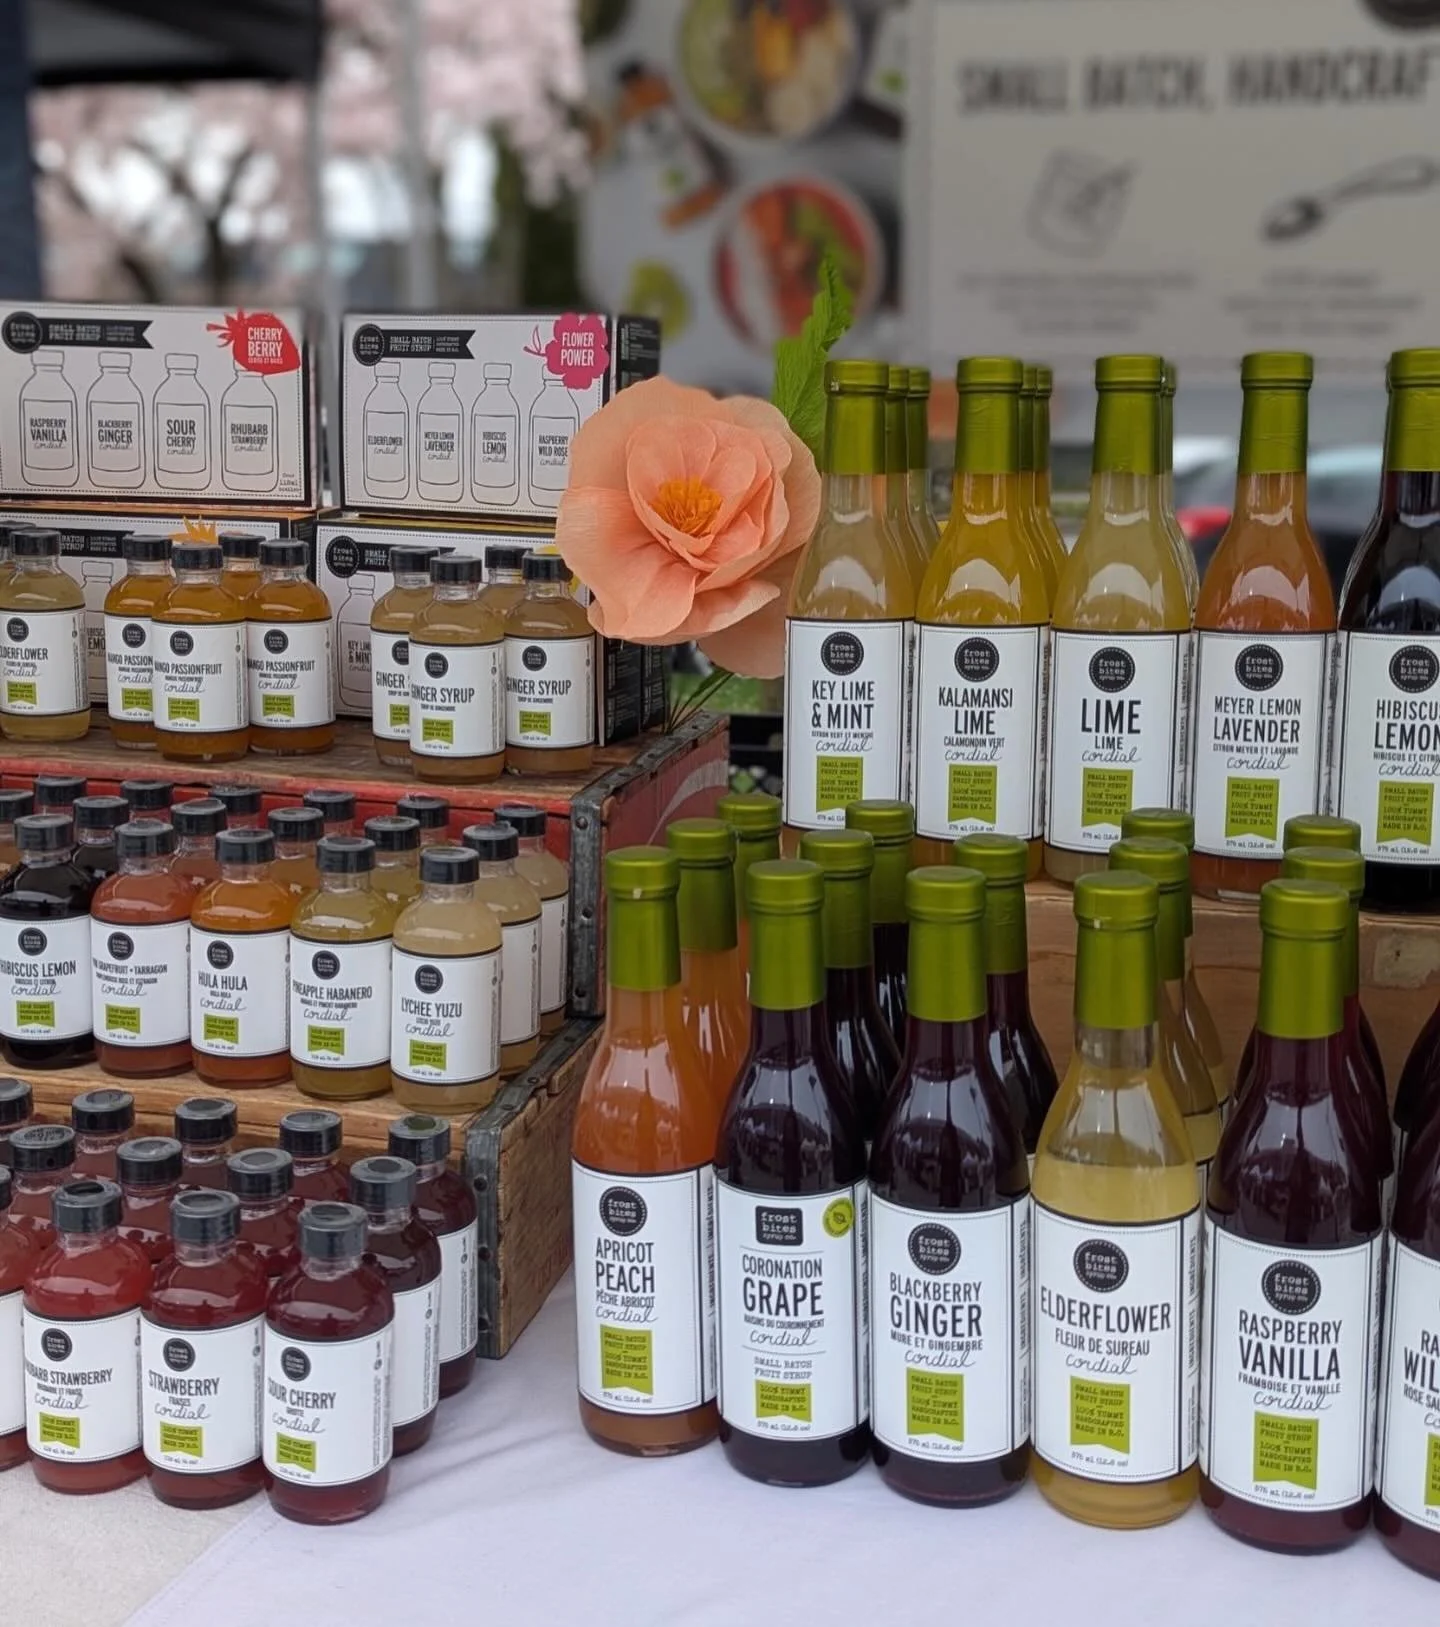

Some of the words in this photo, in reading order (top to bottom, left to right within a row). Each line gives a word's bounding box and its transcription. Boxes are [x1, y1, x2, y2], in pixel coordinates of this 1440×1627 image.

[248, 327, 283, 341] CHERRY
[562, 332, 594, 347] FLOWER
[248, 342, 283, 357] BERRY
[560, 349, 594, 366] POWER
[30, 418, 66, 428] RASPBERRY
[98, 419, 132, 428] BLACKBERRY
[166, 420, 196, 435] SOUR
[230, 424, 268, 435] RHUBARB
[30, 430, 66, 442] VANILLA
[98, 430, 132, 443] GINGER
[166, 436, 196, 448] CHERRY
[232, 436, 268, 445] STRAWBERRY
[368, 436, 402, 446] ELDERFLOWER
[538, 435, 568, 445] RASPBERRY
[424, 441, 454, 452] LAVENDER
[482, 442, 506, 455] LEMON
[538, 446, 552, 456] WILD
[830, 642, 855, 651] frost
[964, 648, 990, 657] frost
[266, 660, 315, 672] PASSIONFRUIT
[1099, 659, 1125, 668] frost
[1245, 656, 1274, 665] frost
[1400, 657, 1430, 666] frost
[171, 663, 222, 675] PASSIONFRUIT
[1100, 667, 1125, 675] bites
[1246, 665, 1273, 673] bites
[1400, 667, 1428, 675] bites
[164, 679, 205, 694] cordial
[258, 676, 300, 690] cordial
[376, 672, 405, 687] GINGER
[411, 684, 438, 701] GINGER
[440, 688, 475, 703] SYRUP
[539, 680, 572, 695] SYRUP
[812, 680, 836, 700] KEY
[842, 681, 874, 700] LIME
[938, 687, 1012, 708] KALAMANSI
[1215, 696, 1254, 714] MEYER
[1260, 698, 1301, 716] LEMON
[1376, 699, 1440, 720] HIBISCU
[812, 704, 822, 728] &
[827, 704, 874, 729] MINT
[954, 710, 995, 735] LIME
[1081, 698, 1141, 734] LIME
[1214, 717, 1300, 743] LAVENDER
[816, 736, 872, 752] cordial
[944, 736, 986, 748] CALAMONDIN
[988, 737, 1004, 748] VERT
[1094, 735, 1123, 750] LIME
[1236, 745, 1258, 754] MEYER
[1261, 746, 1268, 754] ET
[945, 745, 1002, 762] cordial
[1082, 748, 1141, 763] cordial
[1374, 752, 1404, 761] HIBISCUS
[1408, 754, 1416, 762] ET
[1227, 752, 1290, 771] cordial
[1378, 760, 1440, 777] cordial
[42, 960, 76, 978] LEMON
[134, 964, 167, 974] TARRAGON
[198, 970, 218, 989] HULA
[221, 976, 248, 991] HULA
[11, 980, 61, 997] cordial
[101, 984, 147, 997] cordial
[327, 986, 372, 1000] HABANERO
[200, 998, 246, 1012] cordial
[401, 998, 432, 1017] LYCHEE
[435, 1002, 462, 1018] YUZU
[304, 1008, 352, 1022] cordial
[405, 1022, 454, 1037] cordial
[608, 1198, 636, 1209] frost
[608, 1208, 636, 1218] bites
[760, 1211, 797, 1222] frost
[762, 1222, 796, 1233] bites
[918, 1235, 950, 1247] frost
[596, 1237, 654, 1264] APRICOT
[919, 1246, 950, 1256] bites
[742, 1253, 822, 1278] CORONATION
[1085, 1253, 1118, 1264] frost
[1085, 1263, 1117, 1273] bites
[595, 1261, 655, 1294] PEACH
[1274, 1274, 1308, 1286] frost
[890, 1272, 982, 1302] BLACKBERRY
[1274, 1284, 1308, 1295] bites
[621, 1296, 655, 1308] ABRICOT
[743, 1277, 824, 1317] GRAPE
[890, 1294, 982, 1338] GINGER
[1041, 1285, 1171, 1334] ELDERFLOWER
[744, 1314, 764, 1327] RAISINS
[766, 1318, 774, 1328] DU
[776, 1318, 824, 1328] COURONNEMENT
[1239, 1309, 1342, 1345] RASPBERRY
[890, 1328, 912, 1346] MURE
[915, 1335, 925, 1348] ET
[929, 1338, 983, 1351] GINGEMBRE
[1056, 1327, 1085, 1350] FLEUR
[1088, 1336, 1103, 1354] DE
[1106, 1339, 1150, 1356] SUREAU
[754, 1356, 781, 1368] SMALL
[784, 1358, 812, 1368] BATCH
[904, 1346, 975, 1368] cordial
[1066, 1353, 1137, 1375] cordial
[1239, 1336, 1340, 1380] VANILLA
[50, 1368, 114, 1386] STRAWBERRY
[754, 1368, 780, 1378] FRUIT
[784, 1369, 812, 1379] SYRUP
[1404, 1347, 1440, 1393] WIL
[149, 1369, 220, 1396] STRAWBERRY
[1238, 1374, 1288, 1392] FRAMBOISE
[1290, 1383, 1301, 1394] ET
[1306, 1383, 1341, 1395] VANILLE
[35, 1392, 89, 1410] cordial
[290, 1389, 336, 1409] CHERRY
[1254, 1389, 1332, 1410] cordial
[1403, 1383, 1424, 1404] ROSE
[155, 1402, 212, 1420] cordial
[272, 1412, 326, 1434] cordial
